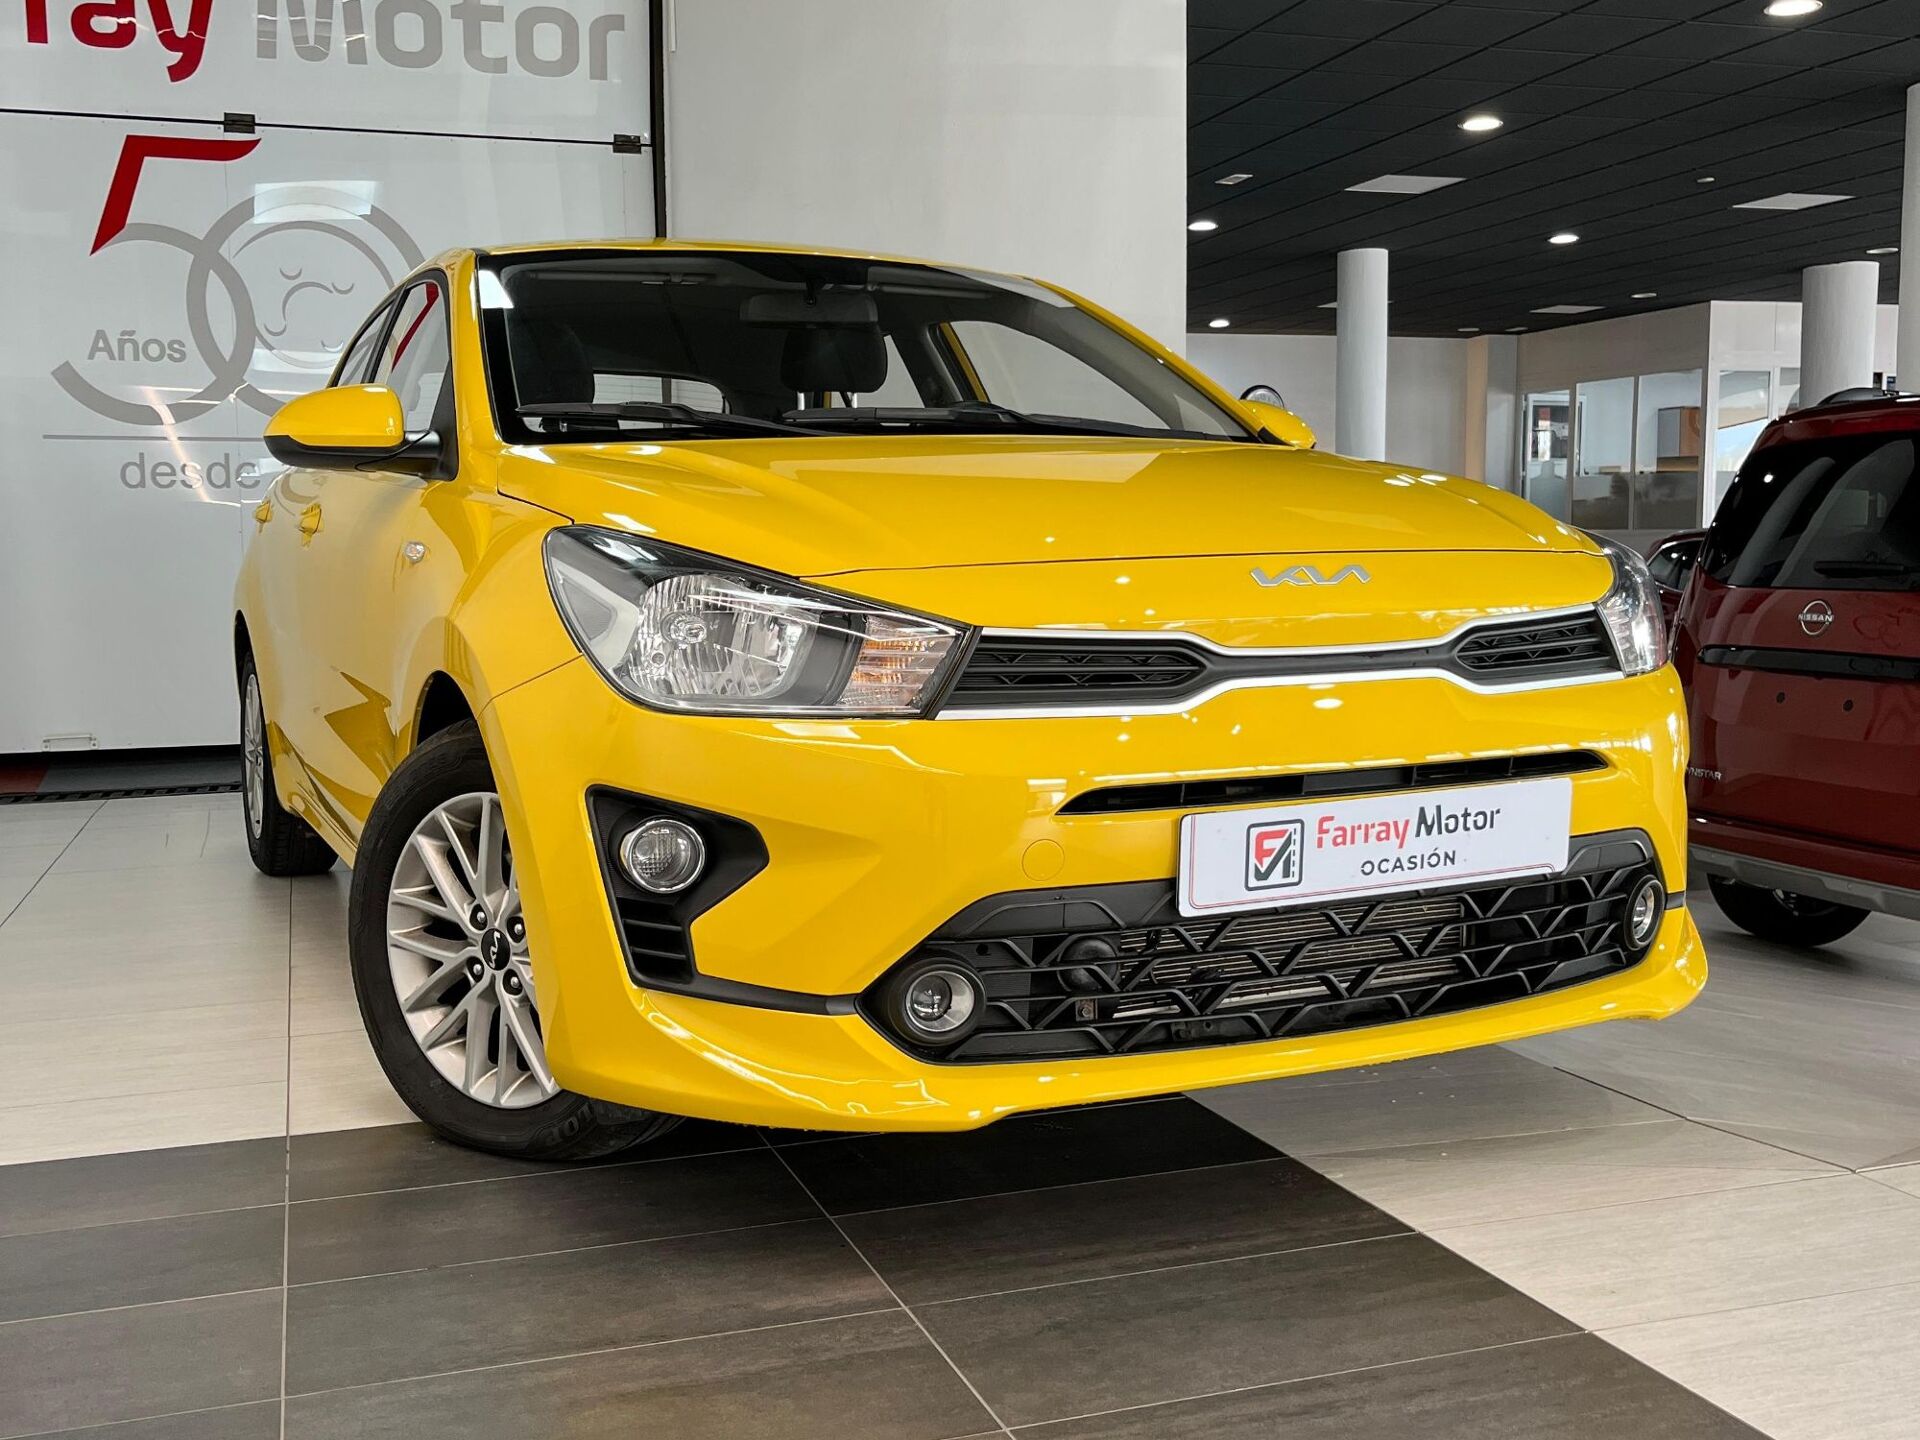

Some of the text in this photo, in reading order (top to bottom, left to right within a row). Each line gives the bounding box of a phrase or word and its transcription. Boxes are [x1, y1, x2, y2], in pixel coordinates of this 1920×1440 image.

[256, 0, 625, 81] Motor
[87, 330, 187, 362] Años
[120, 452, 261, 489] desde
[1250, 564, 1371, 588] KIA
[1798, 613, 1834, 622] NISSAN
[1316, 804, 1501, 849] Farray Motor
[1360, 847, 1456, 876] OCASIÓN
